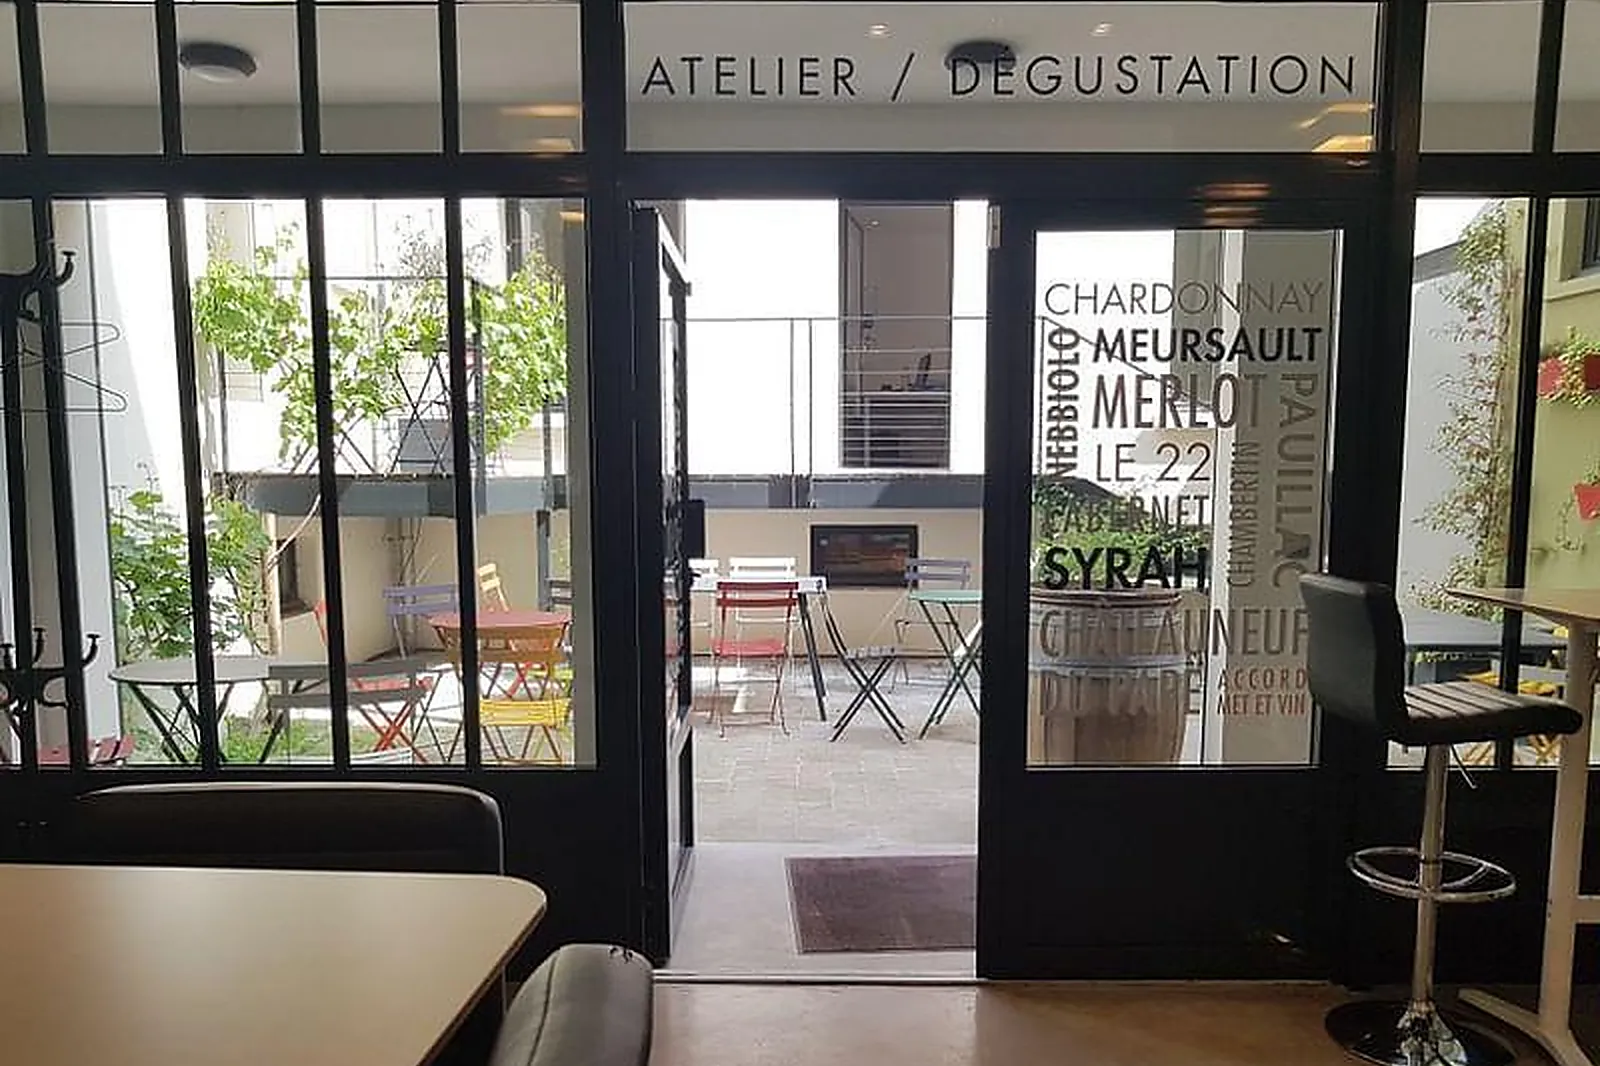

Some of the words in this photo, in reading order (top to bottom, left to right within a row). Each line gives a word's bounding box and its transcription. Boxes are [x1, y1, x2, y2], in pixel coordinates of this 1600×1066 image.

[642, 56, 857, 97] ATELIER
[1045, 281, 1323, 315] CHARDONNAY
[1093, 327, 1322, 363] MEURSAULT
[1046, 327, 1080, 483] NEBBIOLO
[1093, 374, 1268, 429] MERLOT
[1097, 444, 1136, 482] LE
[1156, 443, 1211, 482] 22
[1273, 373, 1319, 588] PAUILLAC
[1229, 441, 1261, 587] CHAMBERTIN
[1044, 546, 1208, 590] SYRAH
